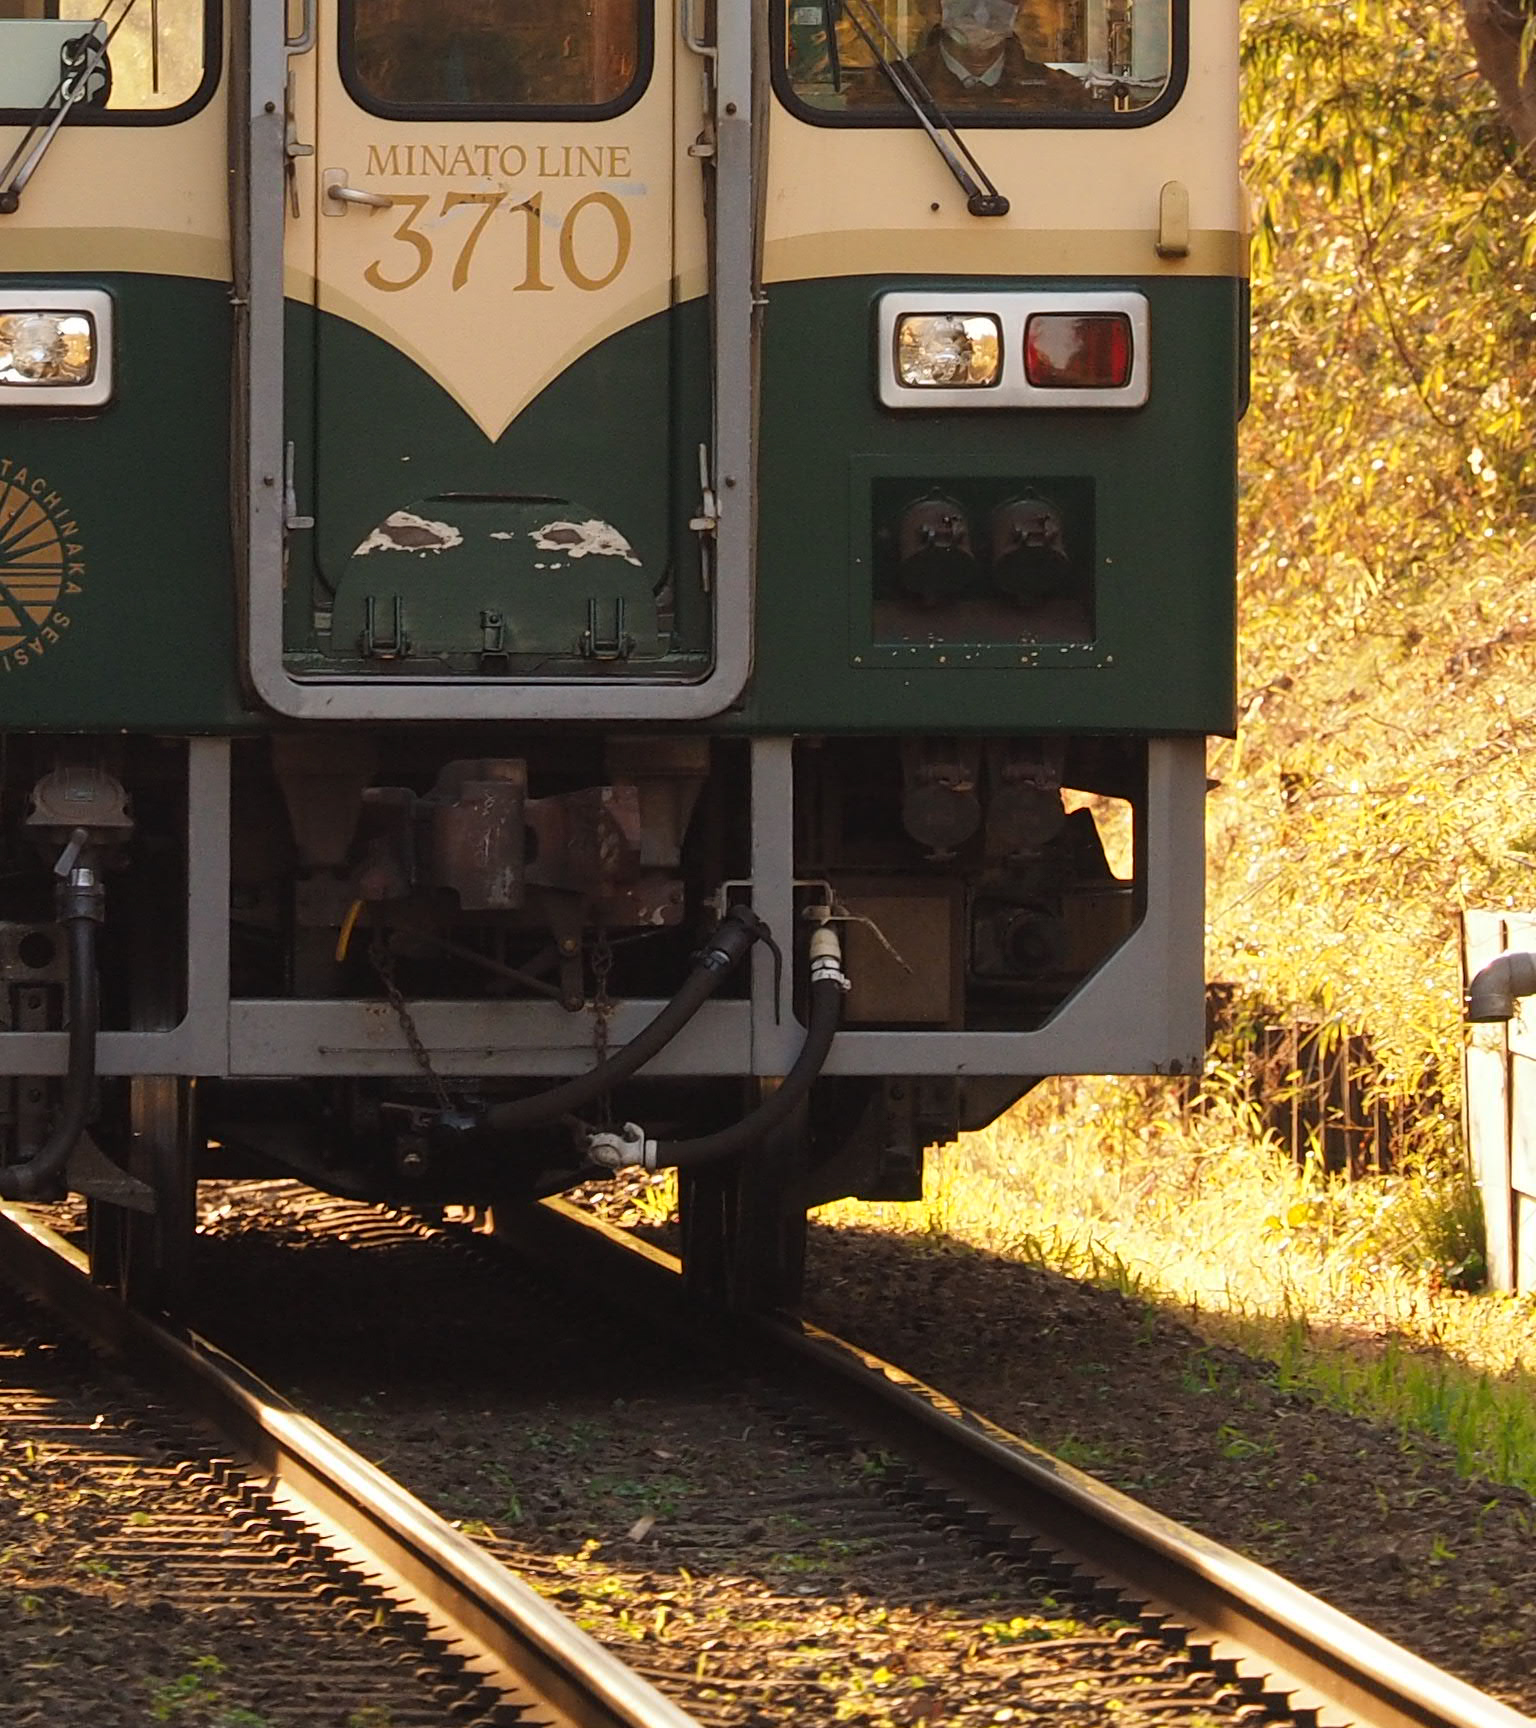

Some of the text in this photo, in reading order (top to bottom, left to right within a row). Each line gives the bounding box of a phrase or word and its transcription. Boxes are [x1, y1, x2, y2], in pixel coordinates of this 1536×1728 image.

[366, 144, 632, 178] MINATO LINE
[363, 190, 632, 292] 3710
